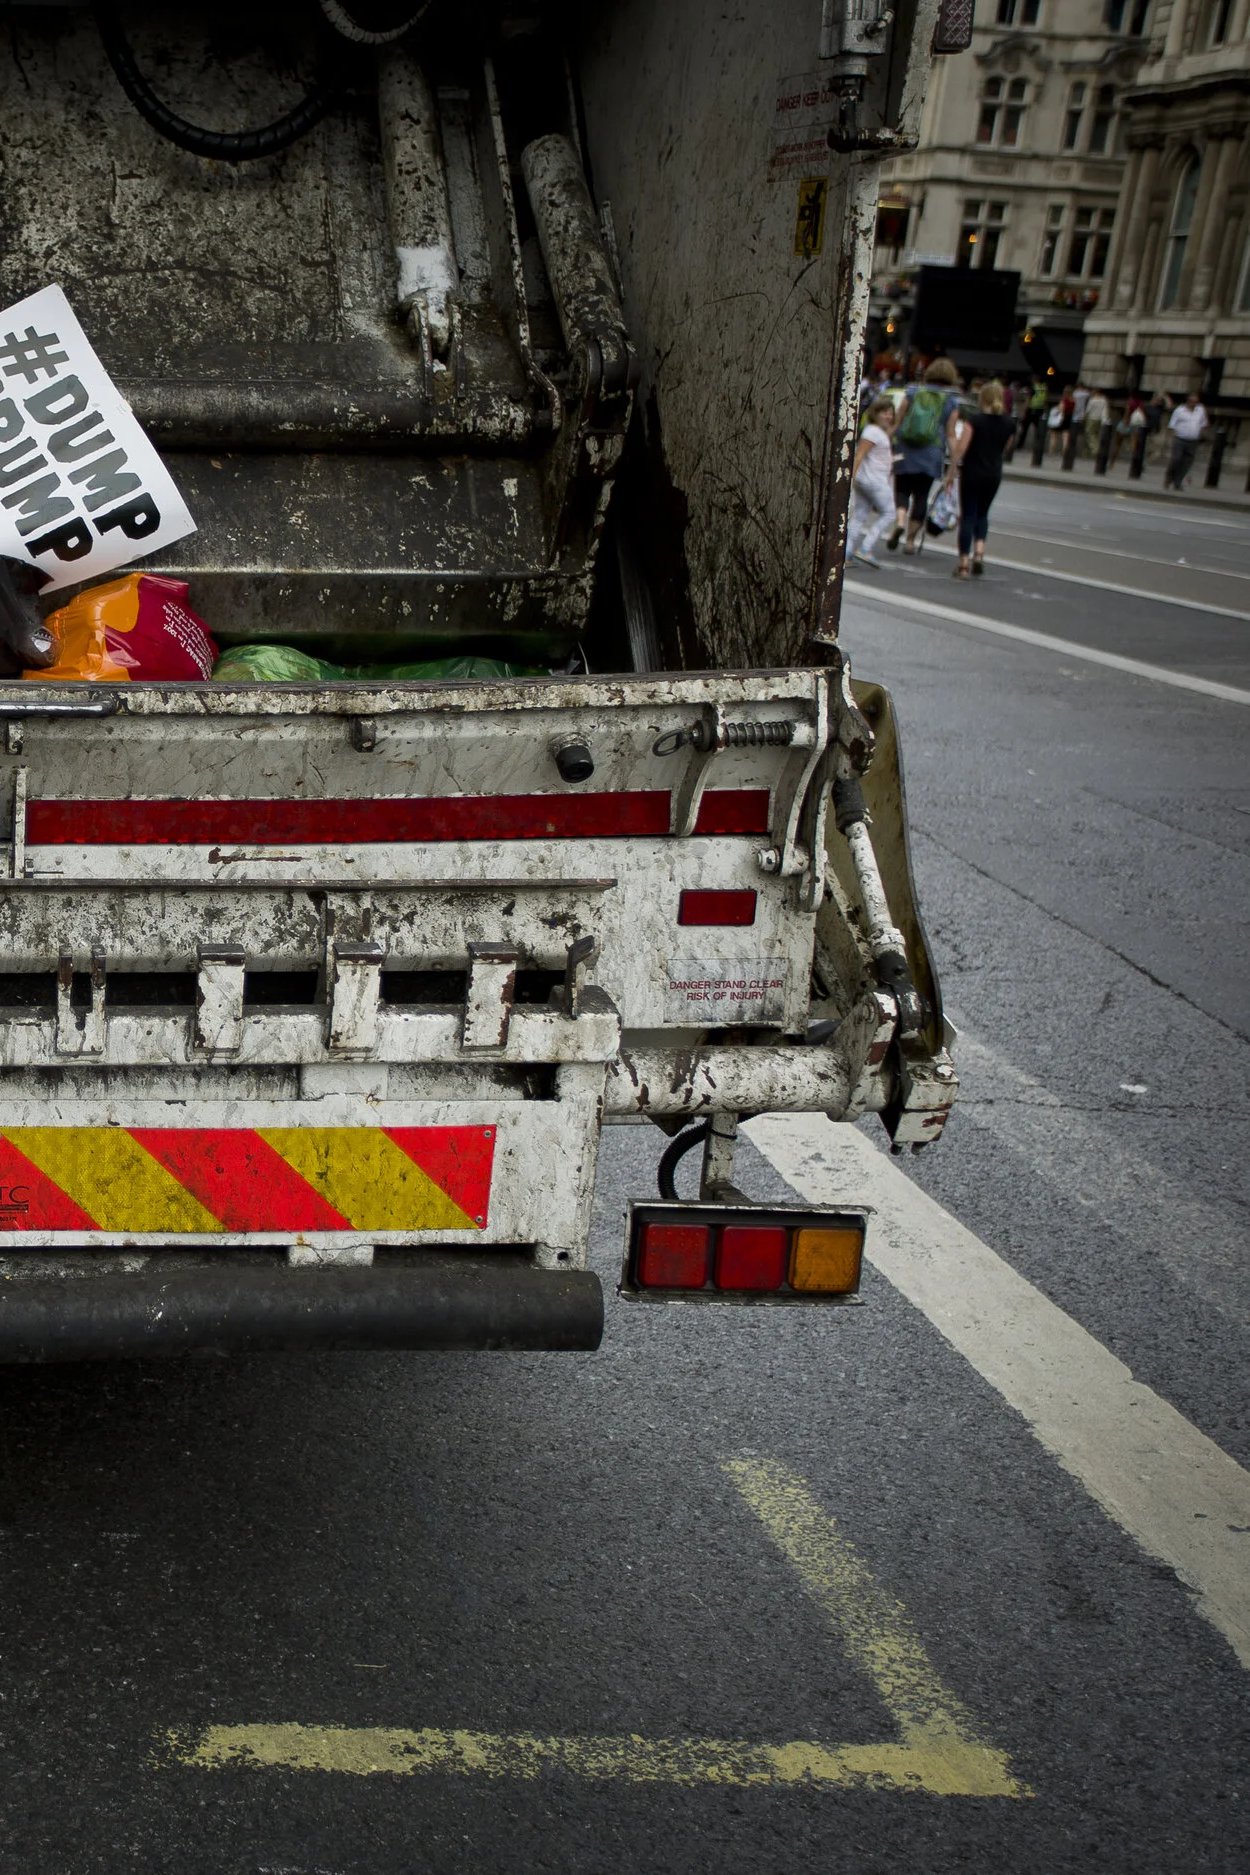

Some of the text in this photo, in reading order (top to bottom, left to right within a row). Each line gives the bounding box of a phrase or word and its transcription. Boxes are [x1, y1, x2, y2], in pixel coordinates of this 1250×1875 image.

[777, 95, 801, 111] DANGER
[803, 92, 819, 107] KEEP
[669, 979, 783, 990] DANGER STAND CLEAR
[686, 991, 765, 1001] RISK OF INJURY
